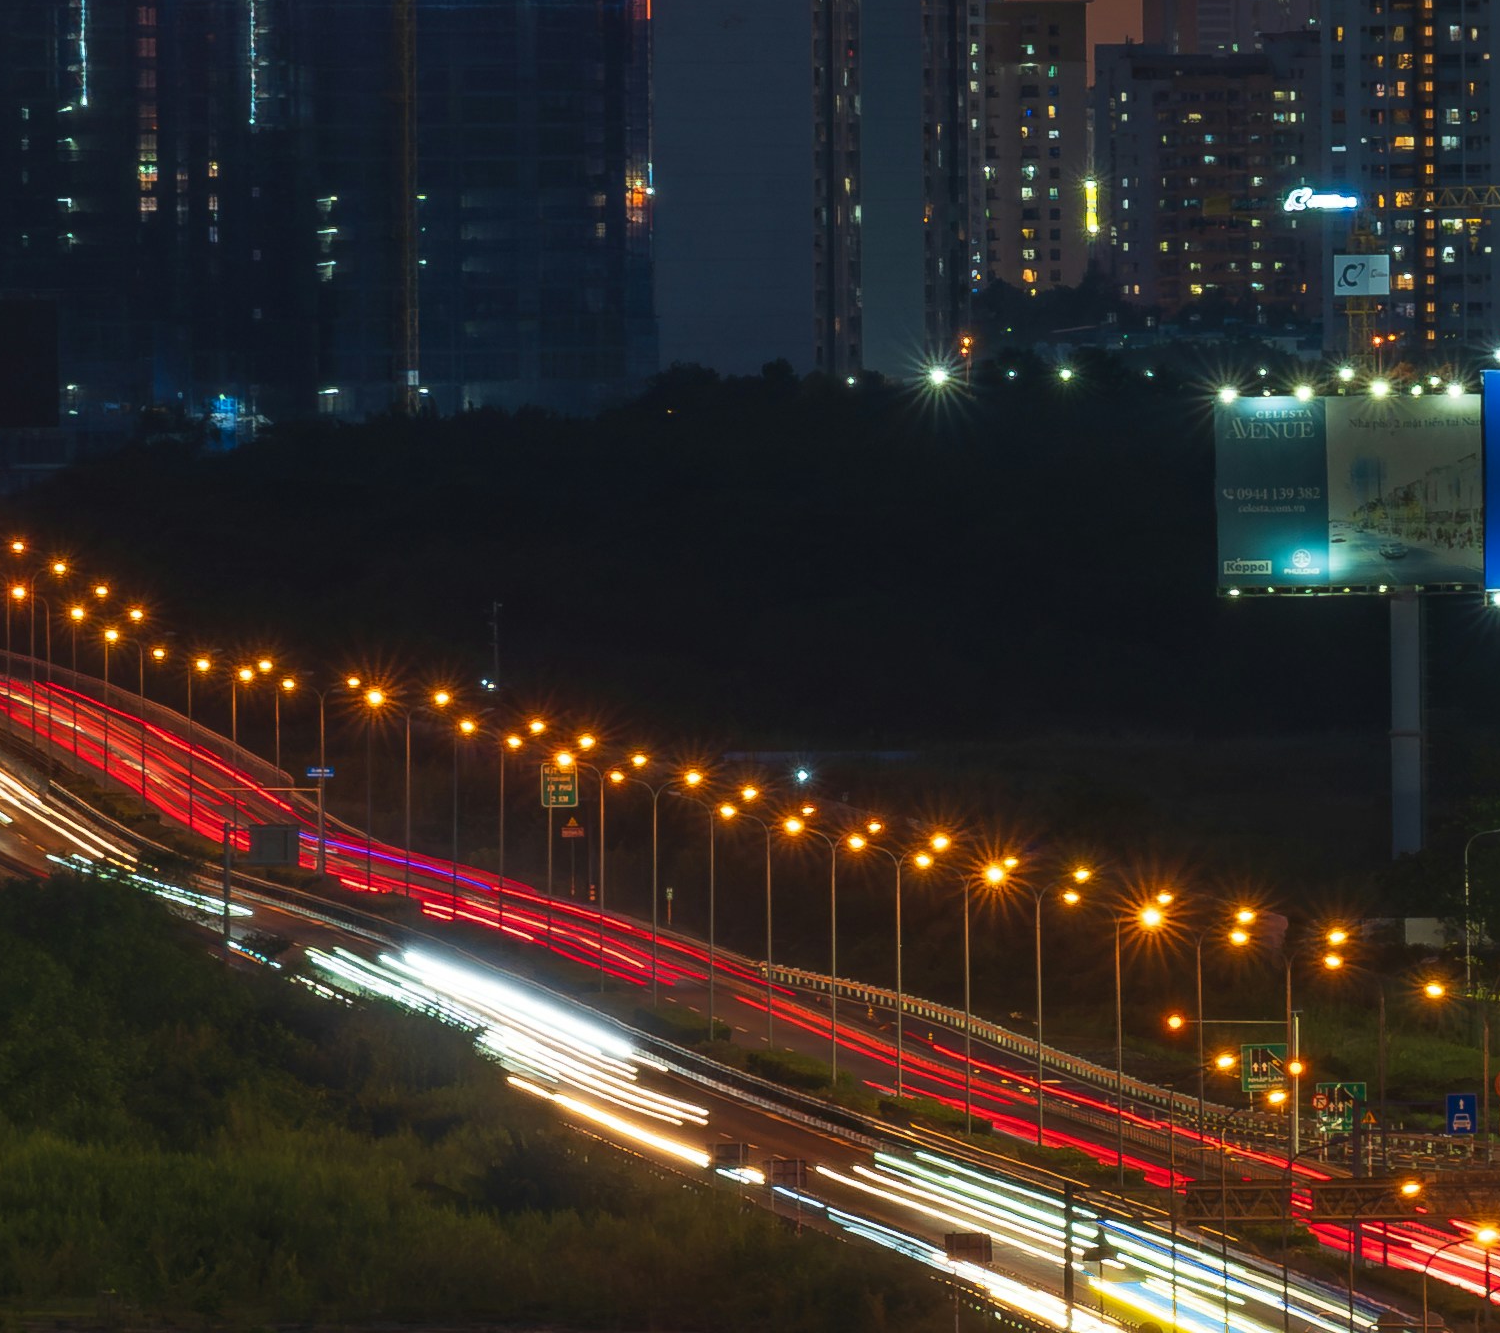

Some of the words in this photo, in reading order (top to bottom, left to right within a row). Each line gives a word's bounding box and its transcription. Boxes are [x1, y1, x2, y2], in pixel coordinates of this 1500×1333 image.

[1255, 409, 1312, 419] CELESTA
[1237, 488, 1268, 501] 0944
[1271, 488, 1294, 501] 139
[1297, 487, 1321, 500] 382
[1226, 560, 1270, 574] Keppel
